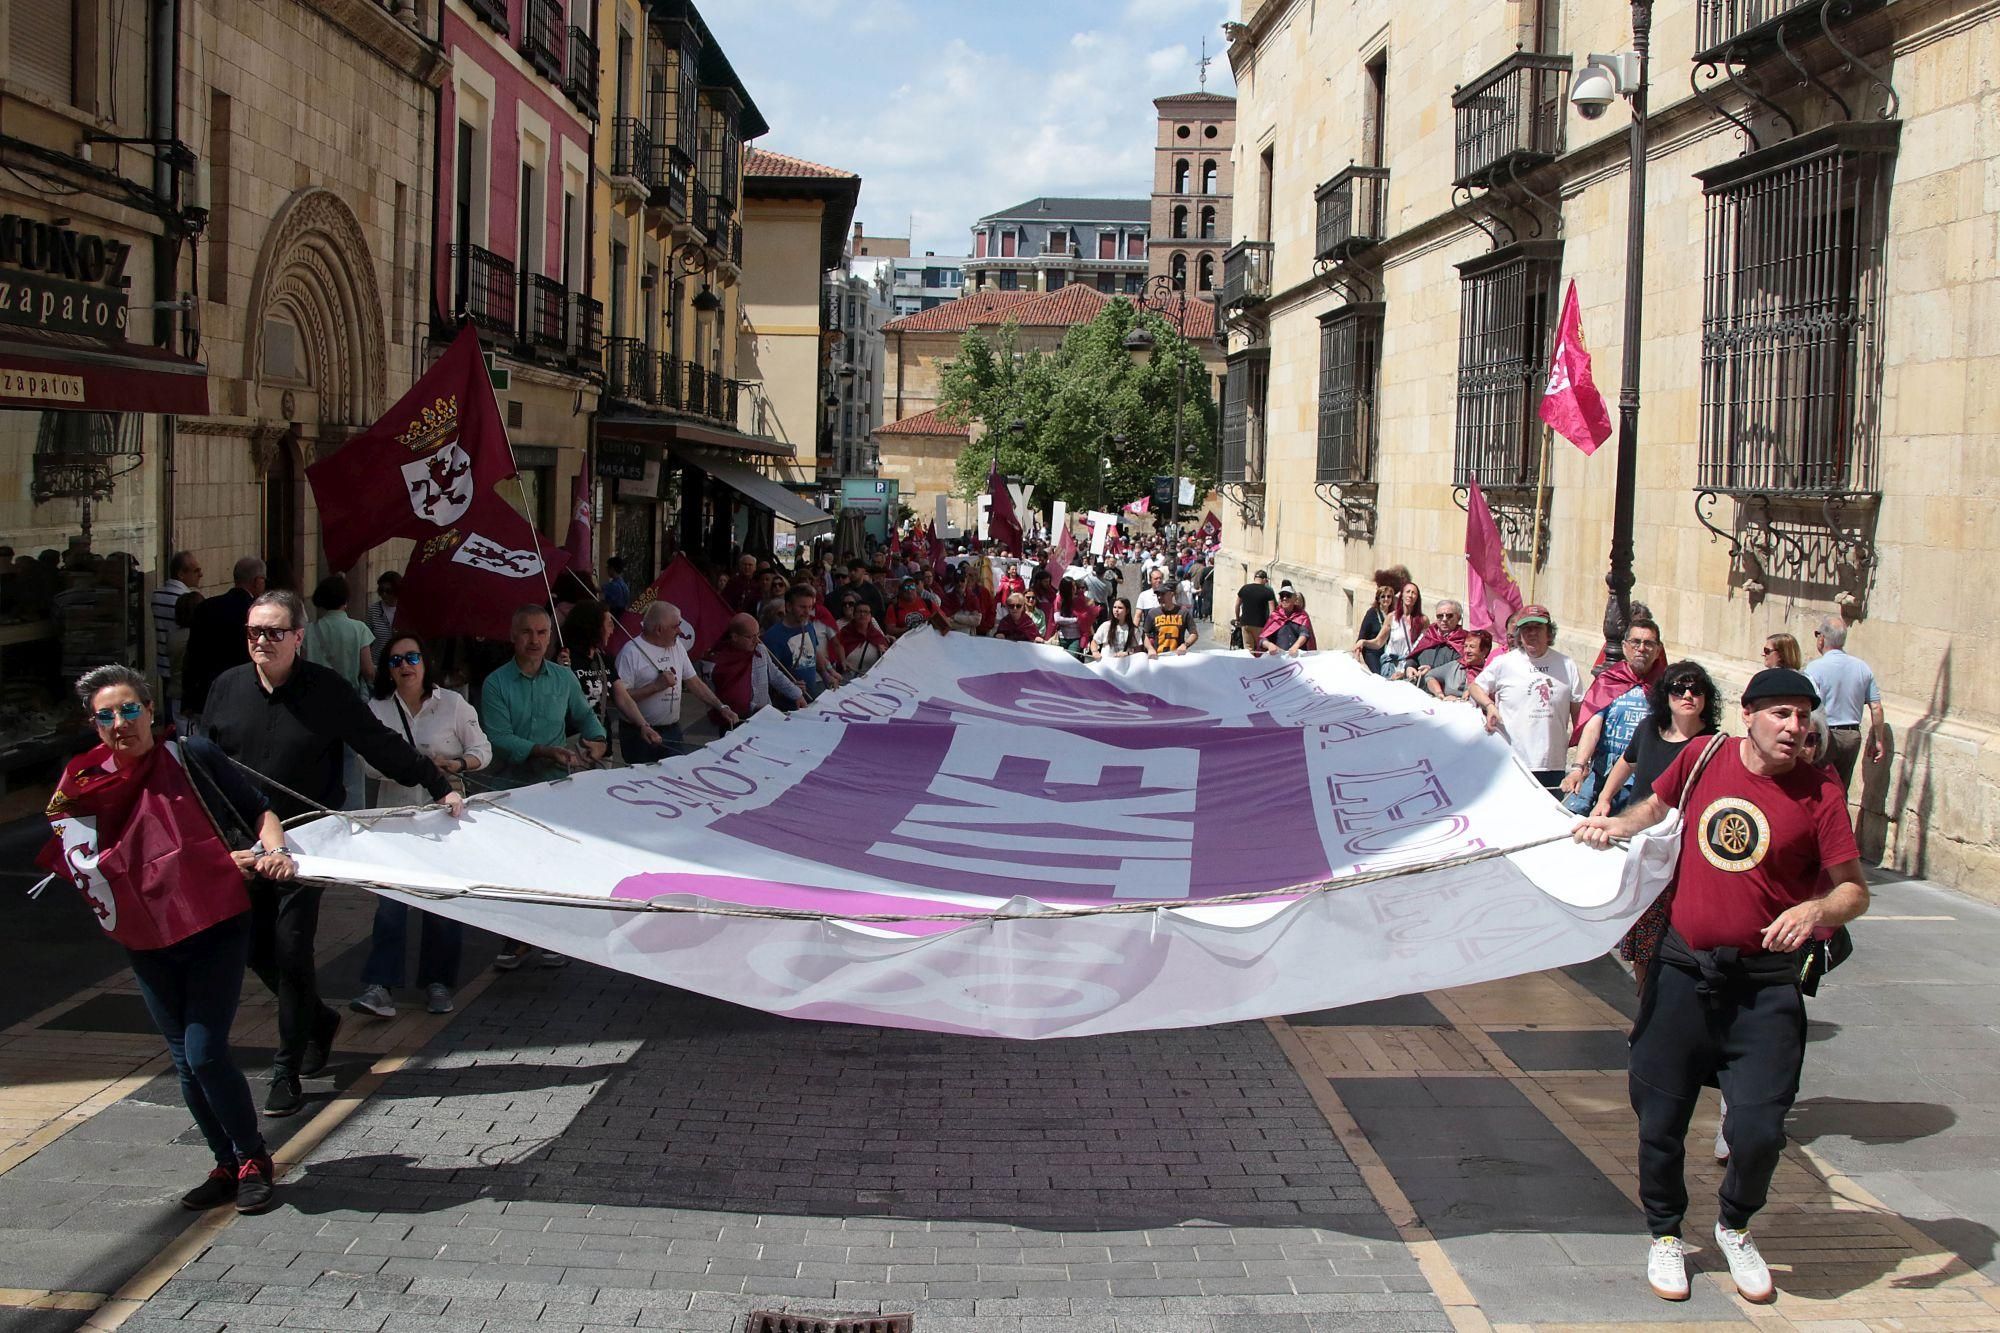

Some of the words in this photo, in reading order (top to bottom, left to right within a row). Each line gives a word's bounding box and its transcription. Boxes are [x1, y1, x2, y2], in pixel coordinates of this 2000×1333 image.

[0, 281, 128, 329] zapatos
[4, 374, 79, 396] zapatos
[876, 482, 885, 493] P
[1155, 614, 1183, 627] OSAKA
